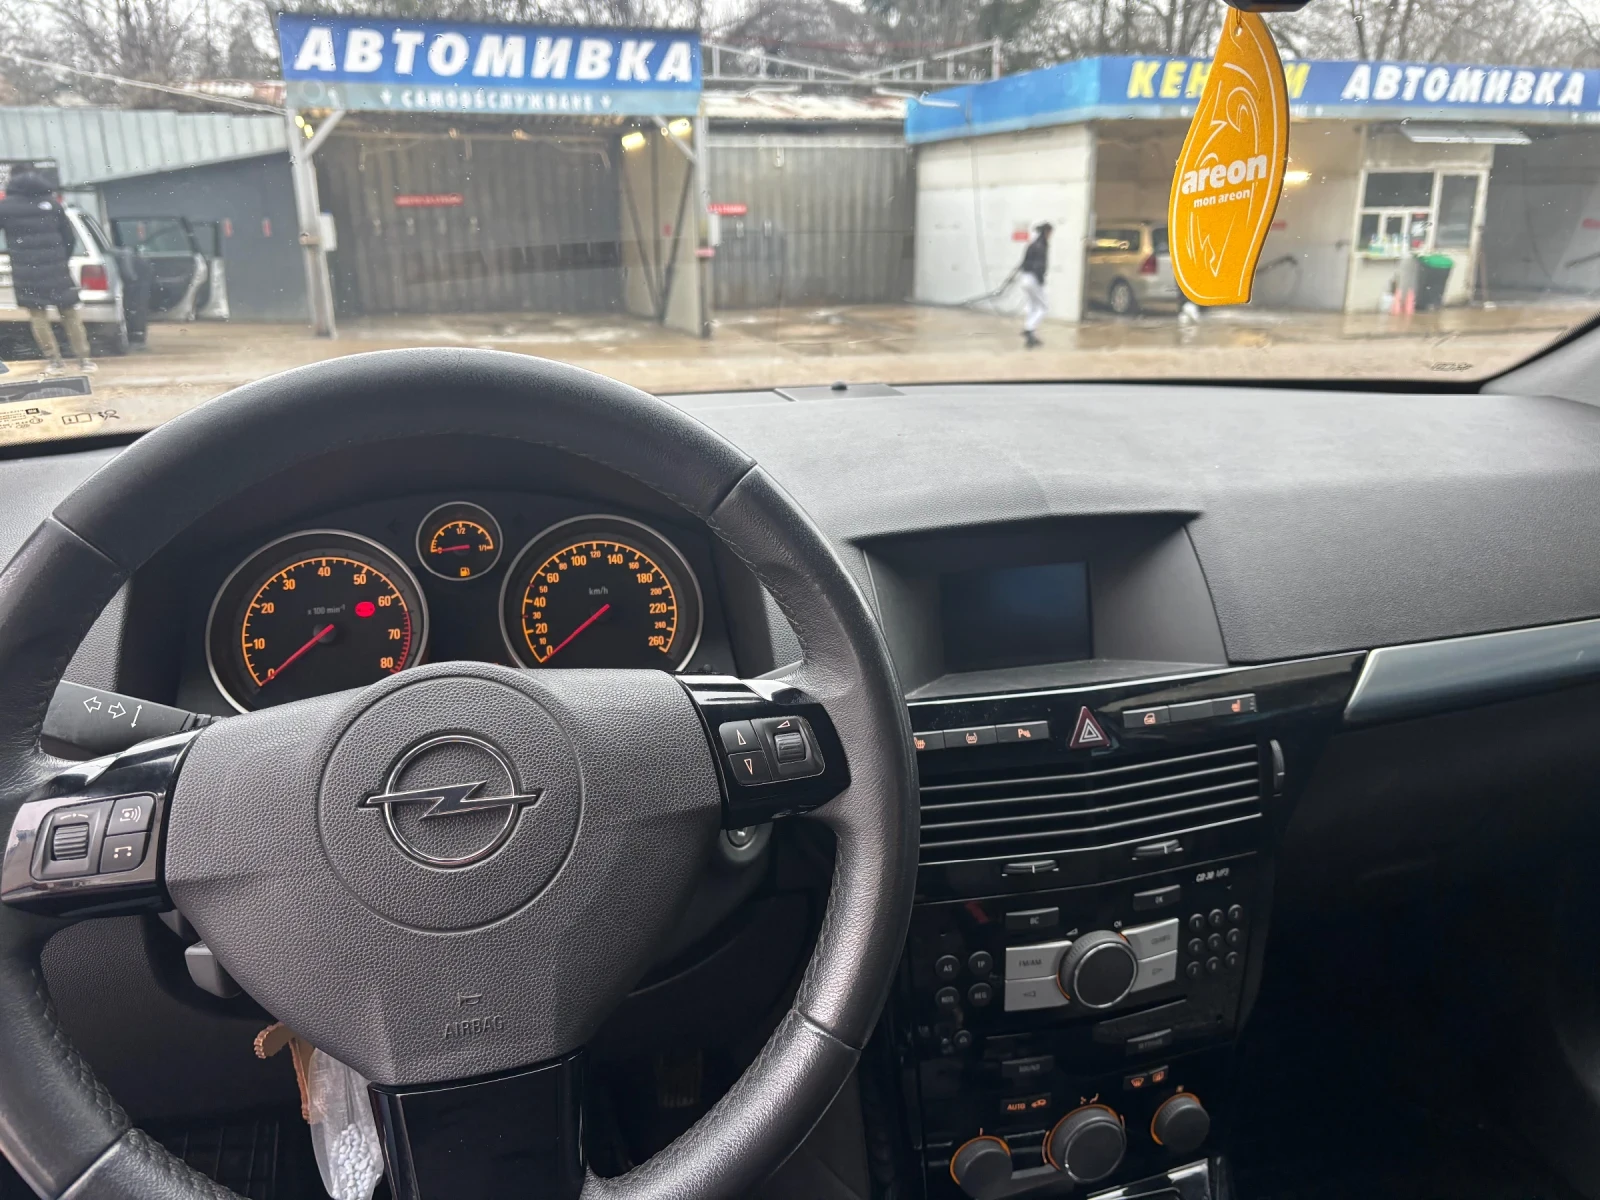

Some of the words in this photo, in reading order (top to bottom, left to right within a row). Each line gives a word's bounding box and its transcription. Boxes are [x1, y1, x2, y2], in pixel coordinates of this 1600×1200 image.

[293, 26, 694, 83] АВТОМИВКА
[1340, 63, 1586, 106] АВТОМИВКА
[1181, 154, 1267, 195] areon
[1193, 195, 1216, 208] mon
[1218, 189, 1251, 204] areon
[570, 555, 587, 566] 100
[607, 553, 623, 565] 140
[558, 562, 567, 570] 80
[628, 561, 640, 570] 160
[317, 567, 331, 577] 40
[546, 572, 559, 583] 60
[353, 574, 367, 585] 50
[636, 572, 653, 584] 180
[282, 578, 296, 590] 30
[539, 585, 548, 594] 50
[588, 586, 609, 596] km/h
[650, 587, 662, 595] 200
[378, 595, 391, 607] 60
[533, 596, 546, 608] 40
[261, 603, 275, 614] 20
[649, 602, 667, 613] 220
[532, 611, 542, 619] 30
[535, 623, 548, 634] 20
[654, 621, 666, 629] 240
[388, 628, 401, 640] 70
[254, 638, 266, 649] 10
[539, 637, 547, 645] 10
[648, 635, 665, 646] 260
[380, 657, 394, 669] 80
[943, 964, 953, 973] AS
[444, 1014, 504, 1040] AIRBAG
[1007, 1103, 1026, 1111] AUTO
